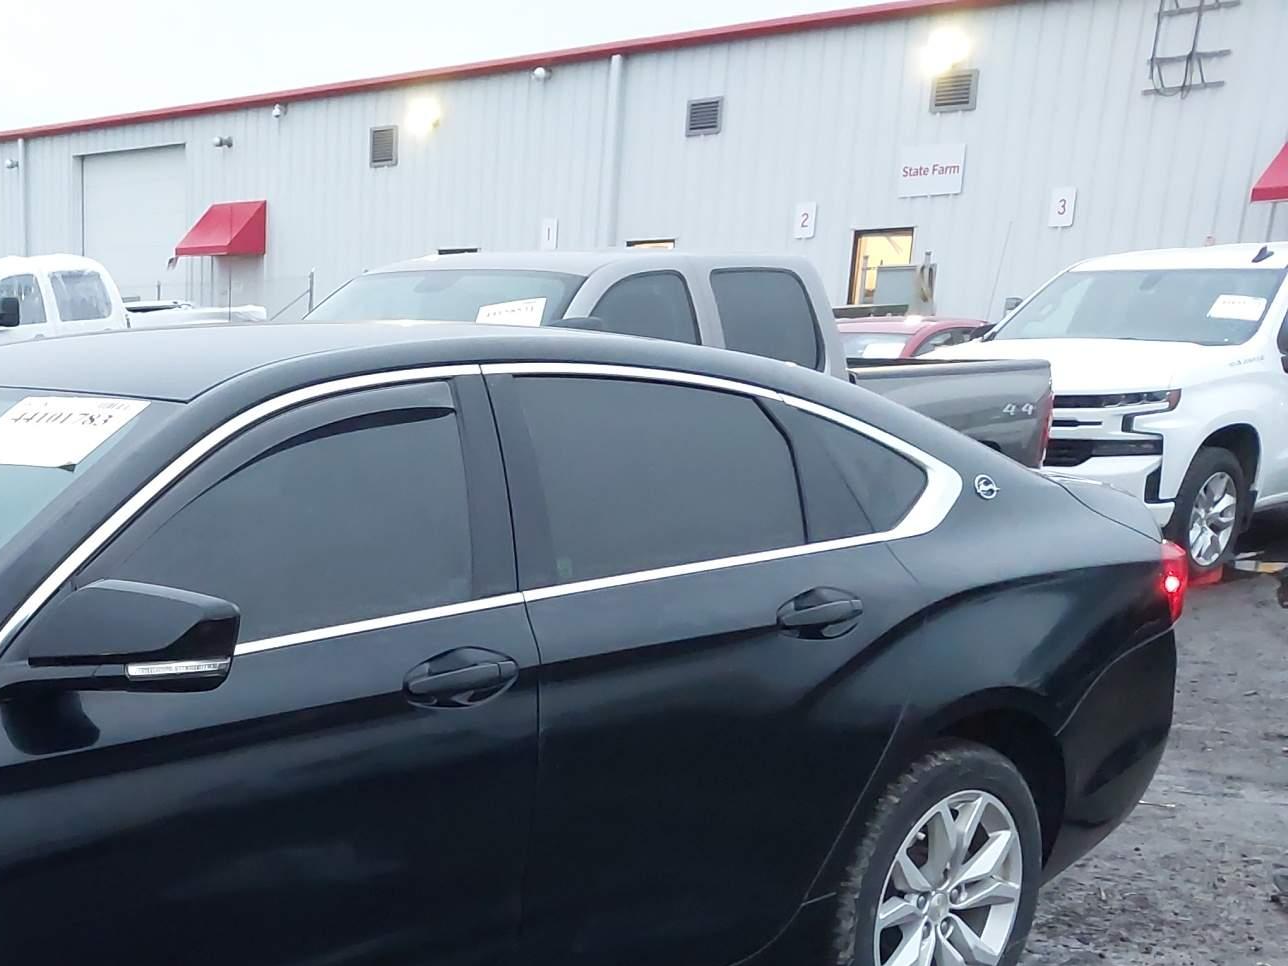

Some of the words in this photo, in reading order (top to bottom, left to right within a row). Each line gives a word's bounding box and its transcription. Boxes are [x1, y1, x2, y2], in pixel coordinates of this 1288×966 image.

[902, 166, 929, 177] State
[932, 164, 960, 175] Farm
[1057, 198, 1066, 215] 3
[801, 212, 809, 228] 2
[11, 411, 113, 427] 44101783
